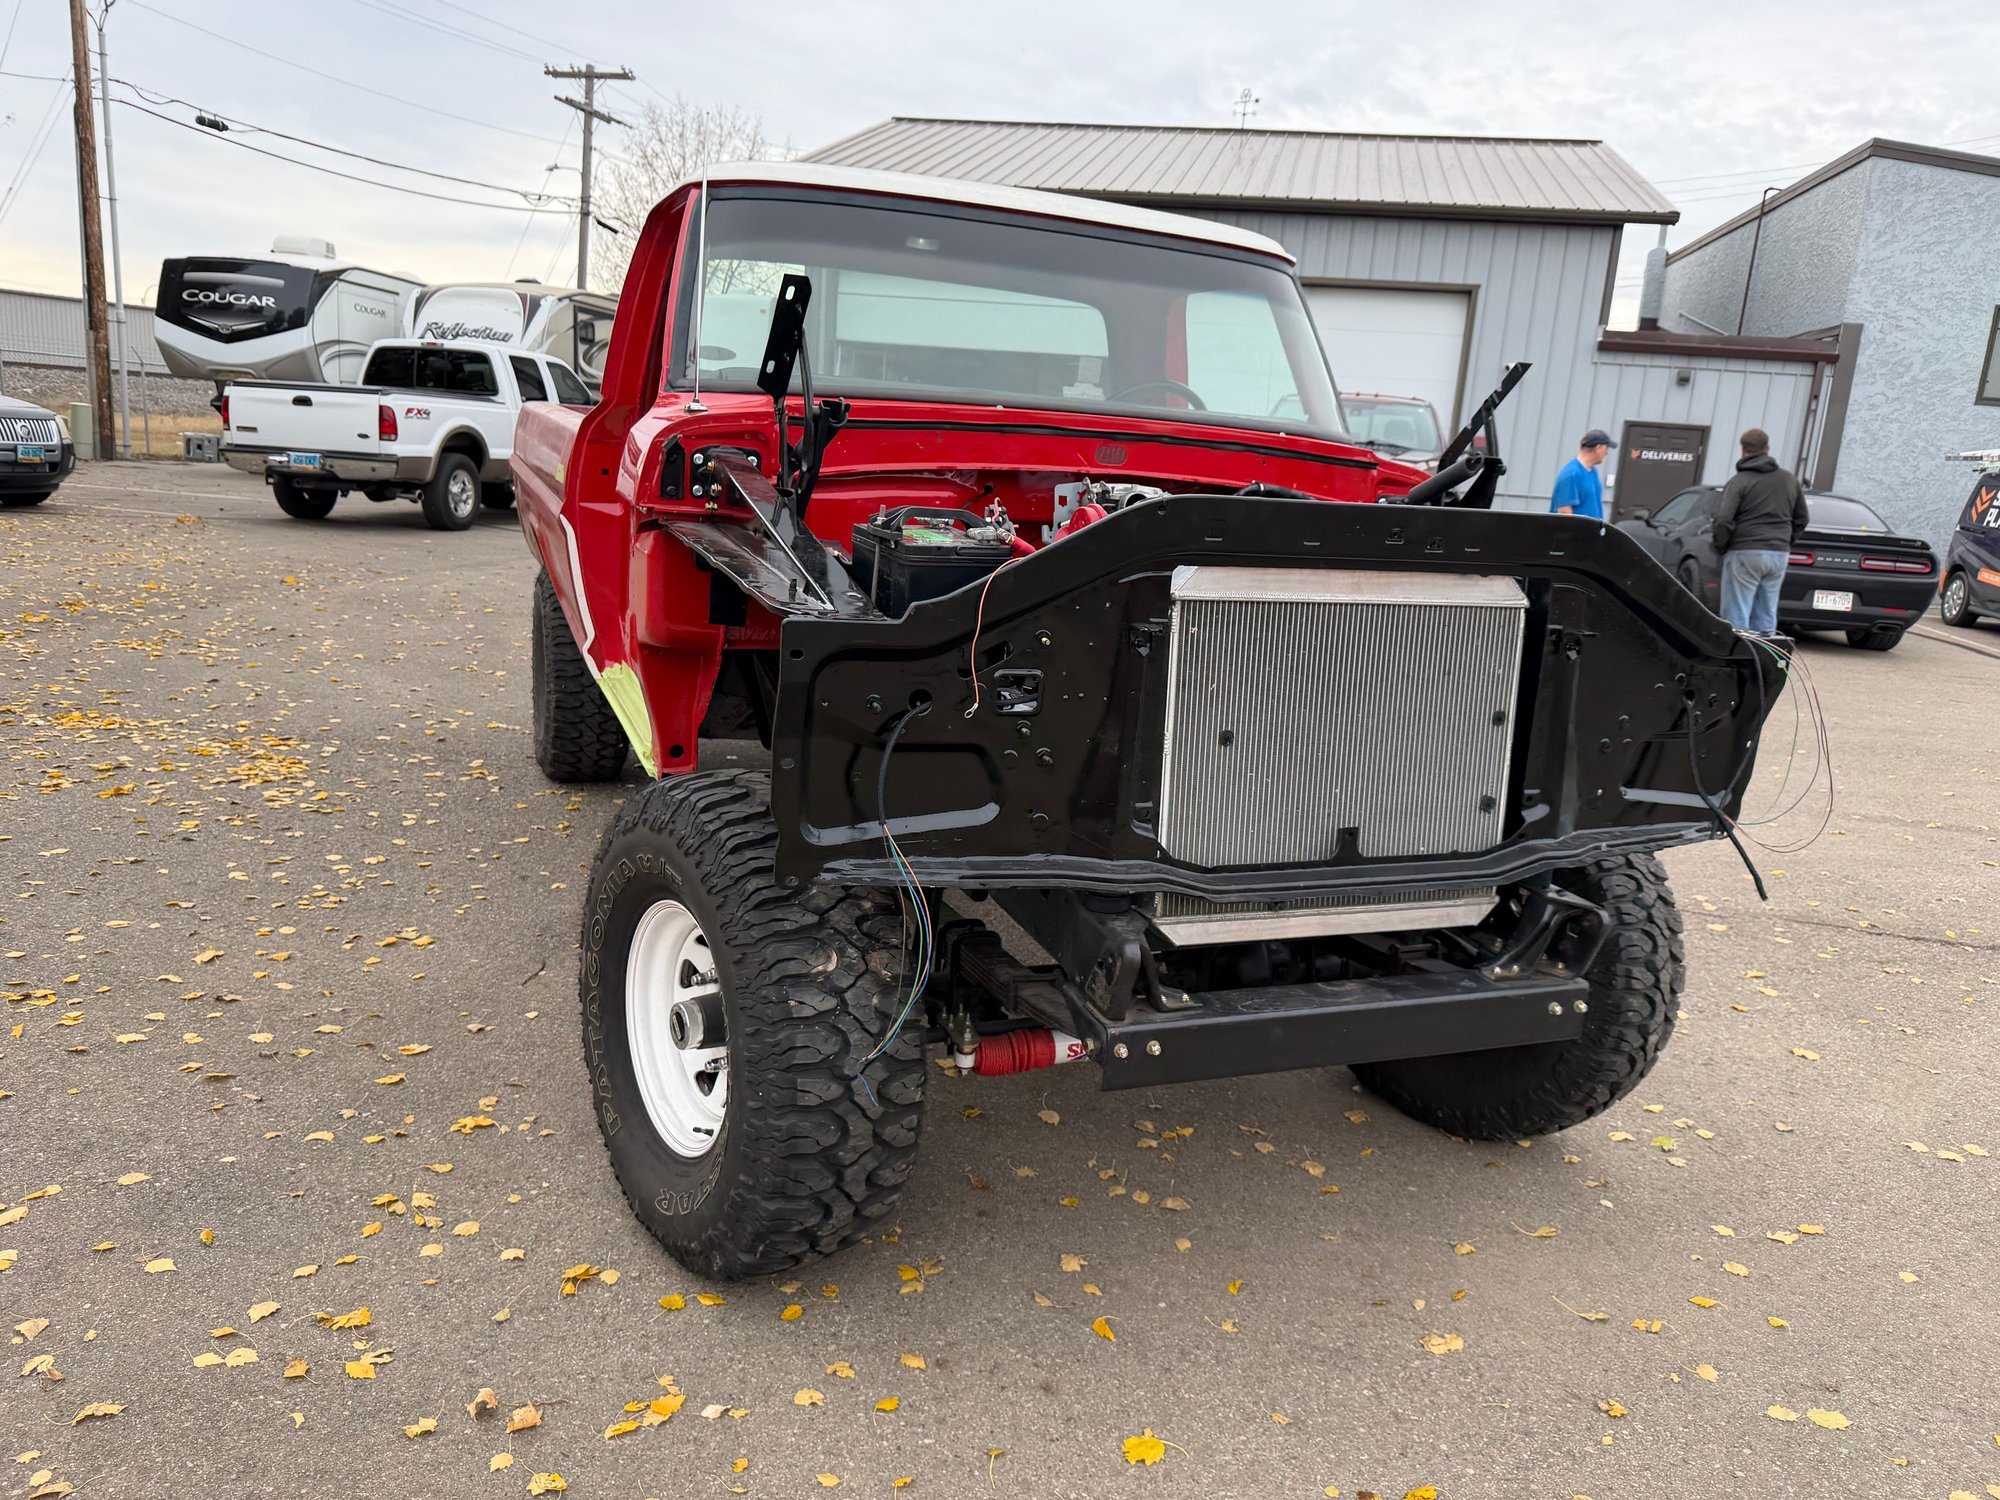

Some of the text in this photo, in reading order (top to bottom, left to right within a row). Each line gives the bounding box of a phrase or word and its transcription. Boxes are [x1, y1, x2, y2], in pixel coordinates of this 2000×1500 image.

[181, 288, 277, 308] COUGAR
[353, 302, 388, 319] COUGAR
[418, 321, 514, 343] Reflection
[404, 407, 432, 416] FX4
[1641, 449, 1694, 462] DELIVERIES
[587, 857, 636, 1136] PATAGONIA
